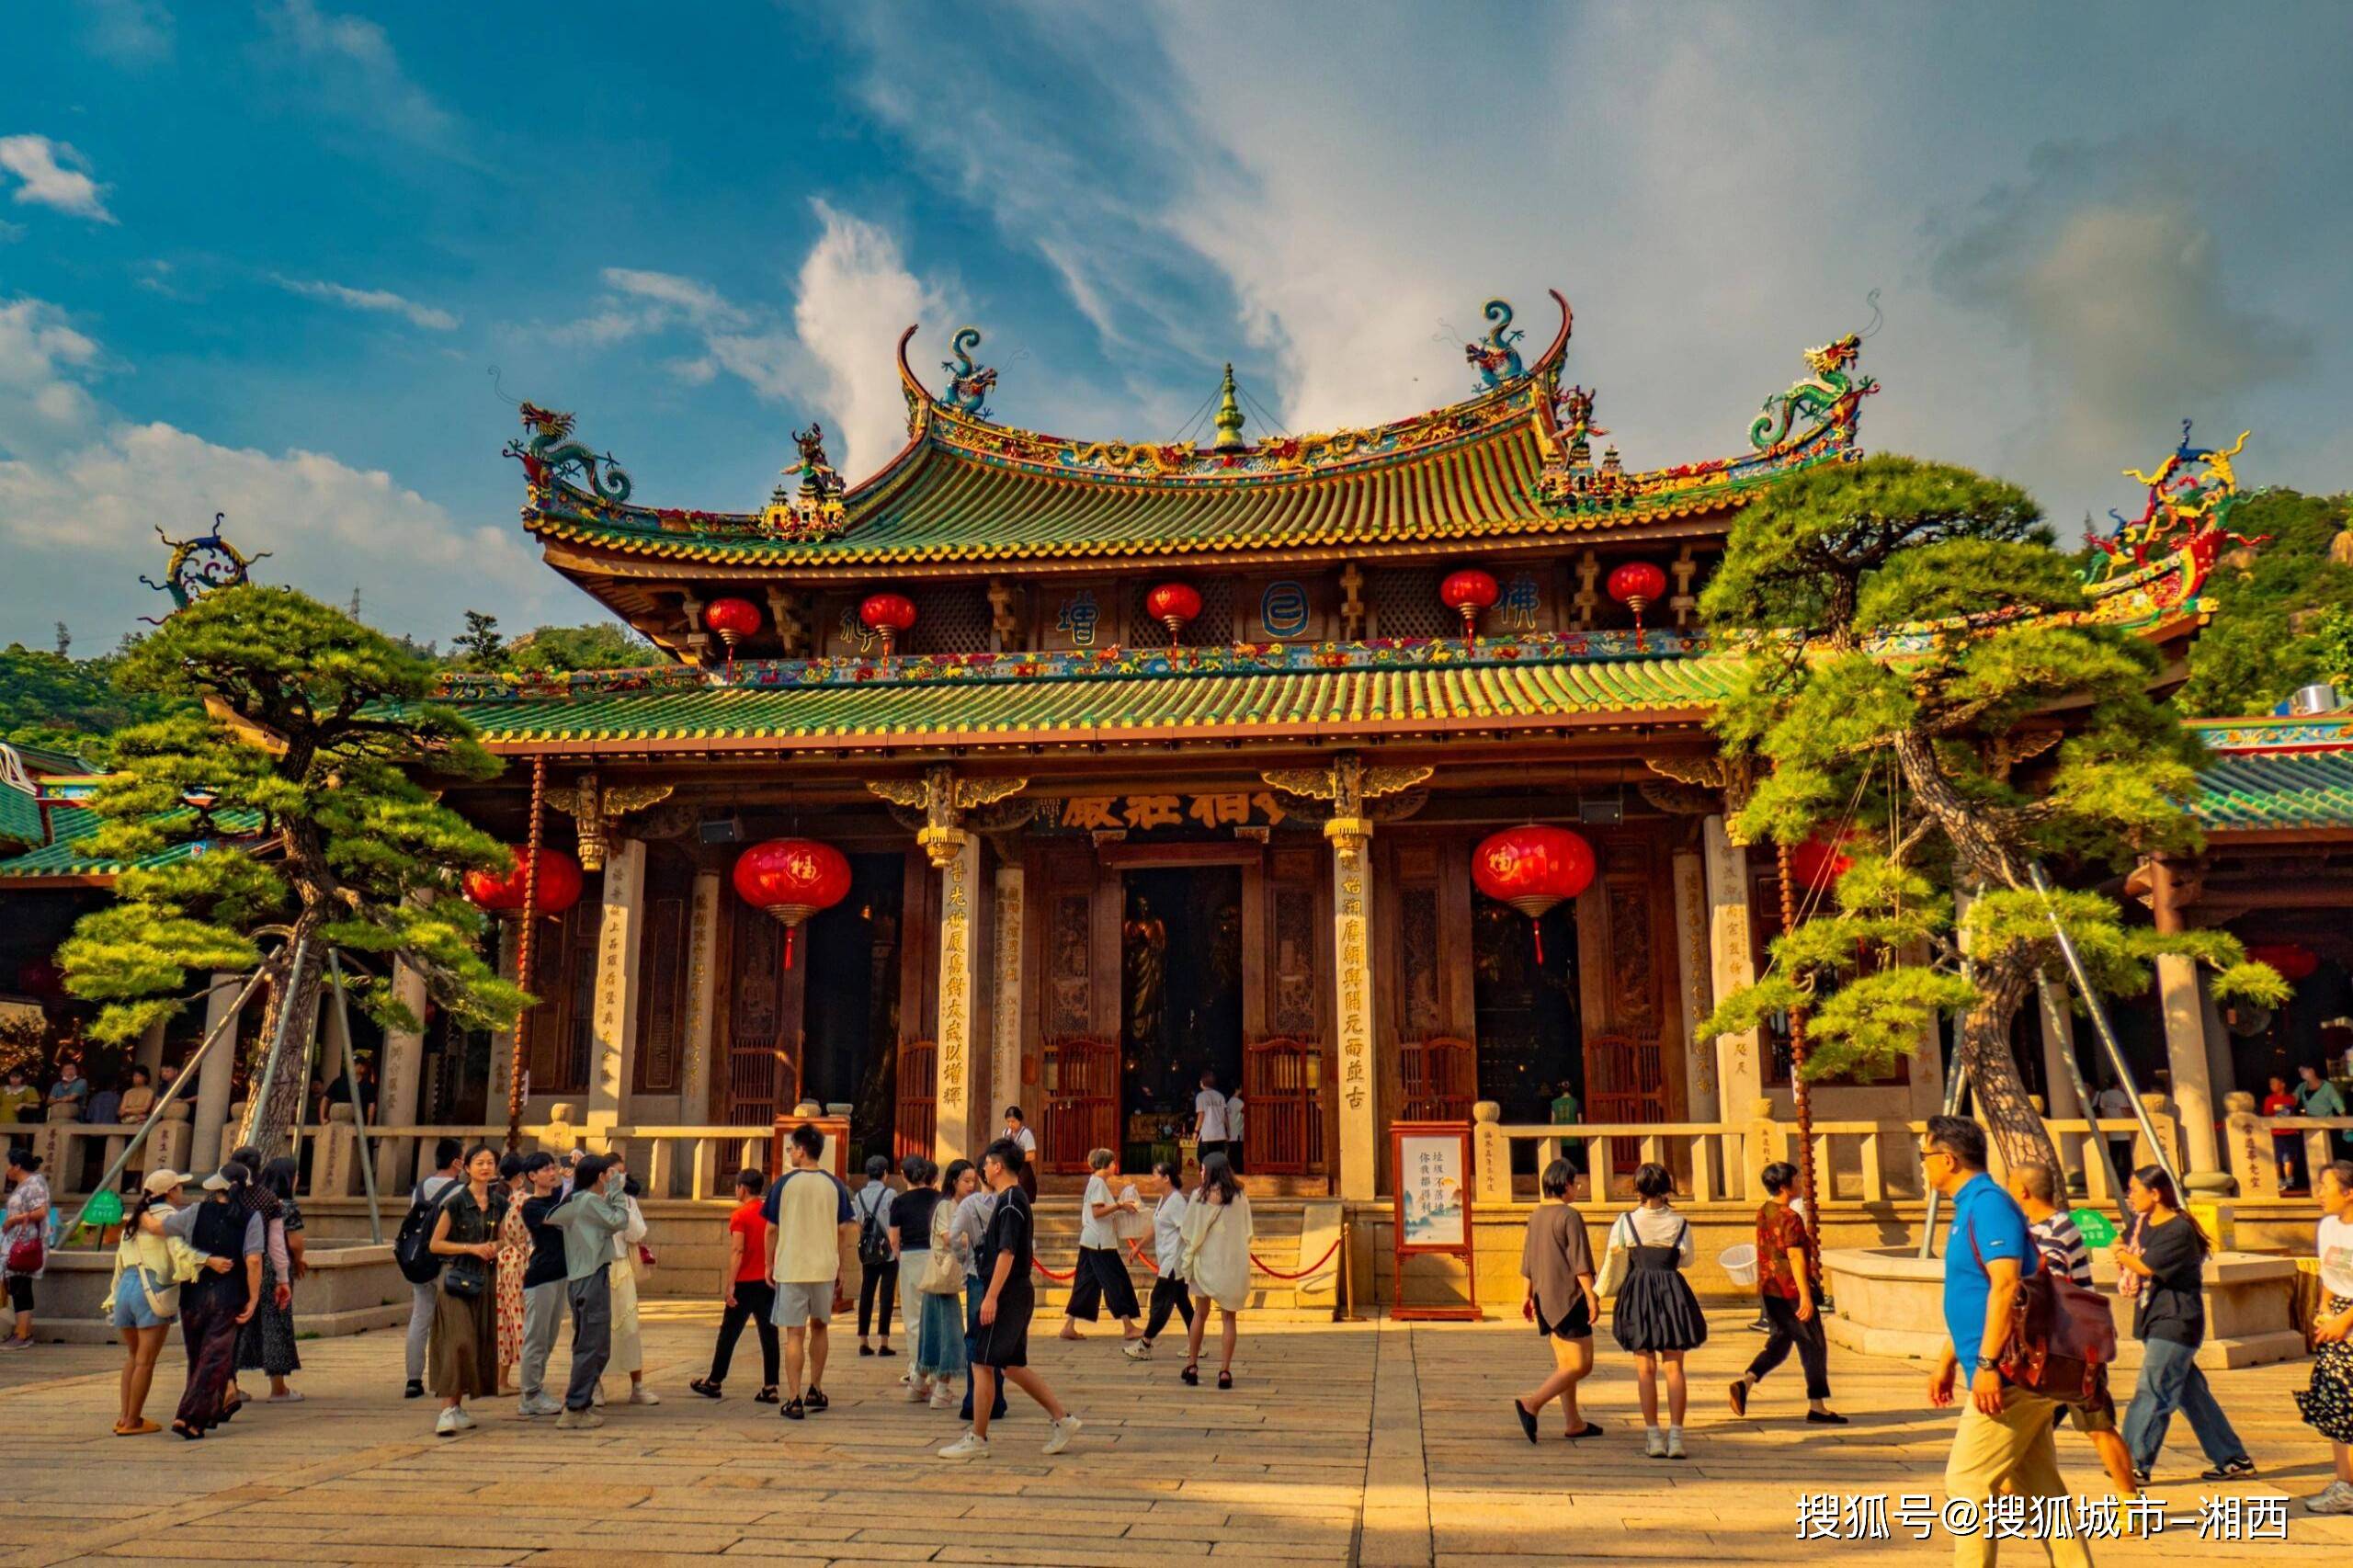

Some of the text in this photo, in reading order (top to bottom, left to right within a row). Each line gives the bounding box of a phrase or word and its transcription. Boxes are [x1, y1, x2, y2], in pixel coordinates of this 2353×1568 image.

[1433, 1152, 1445, 1213] 垃圾不落地
